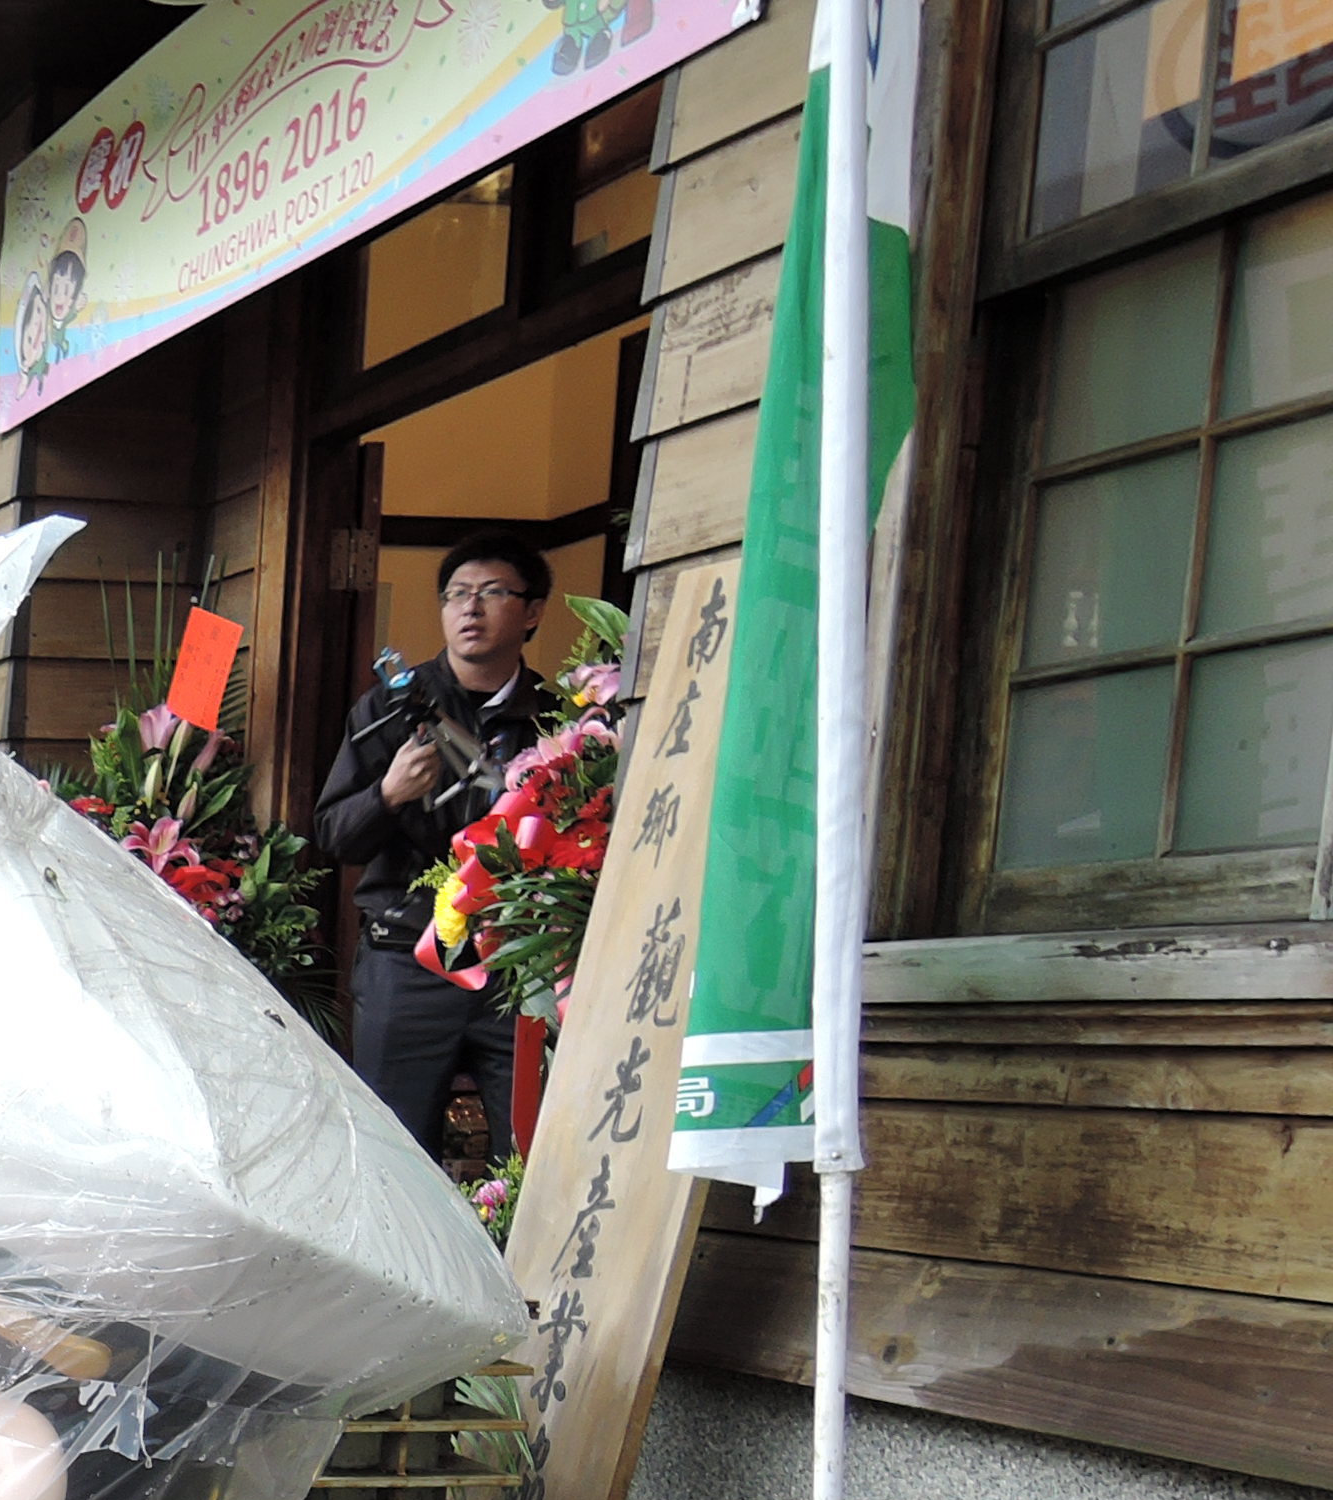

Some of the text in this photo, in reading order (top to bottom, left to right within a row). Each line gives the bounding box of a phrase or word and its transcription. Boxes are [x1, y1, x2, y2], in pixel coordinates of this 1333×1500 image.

[178, 151, 375, 293] CHUNGHWA POST 120
[196, 71, 368, 237] 1896 2016
